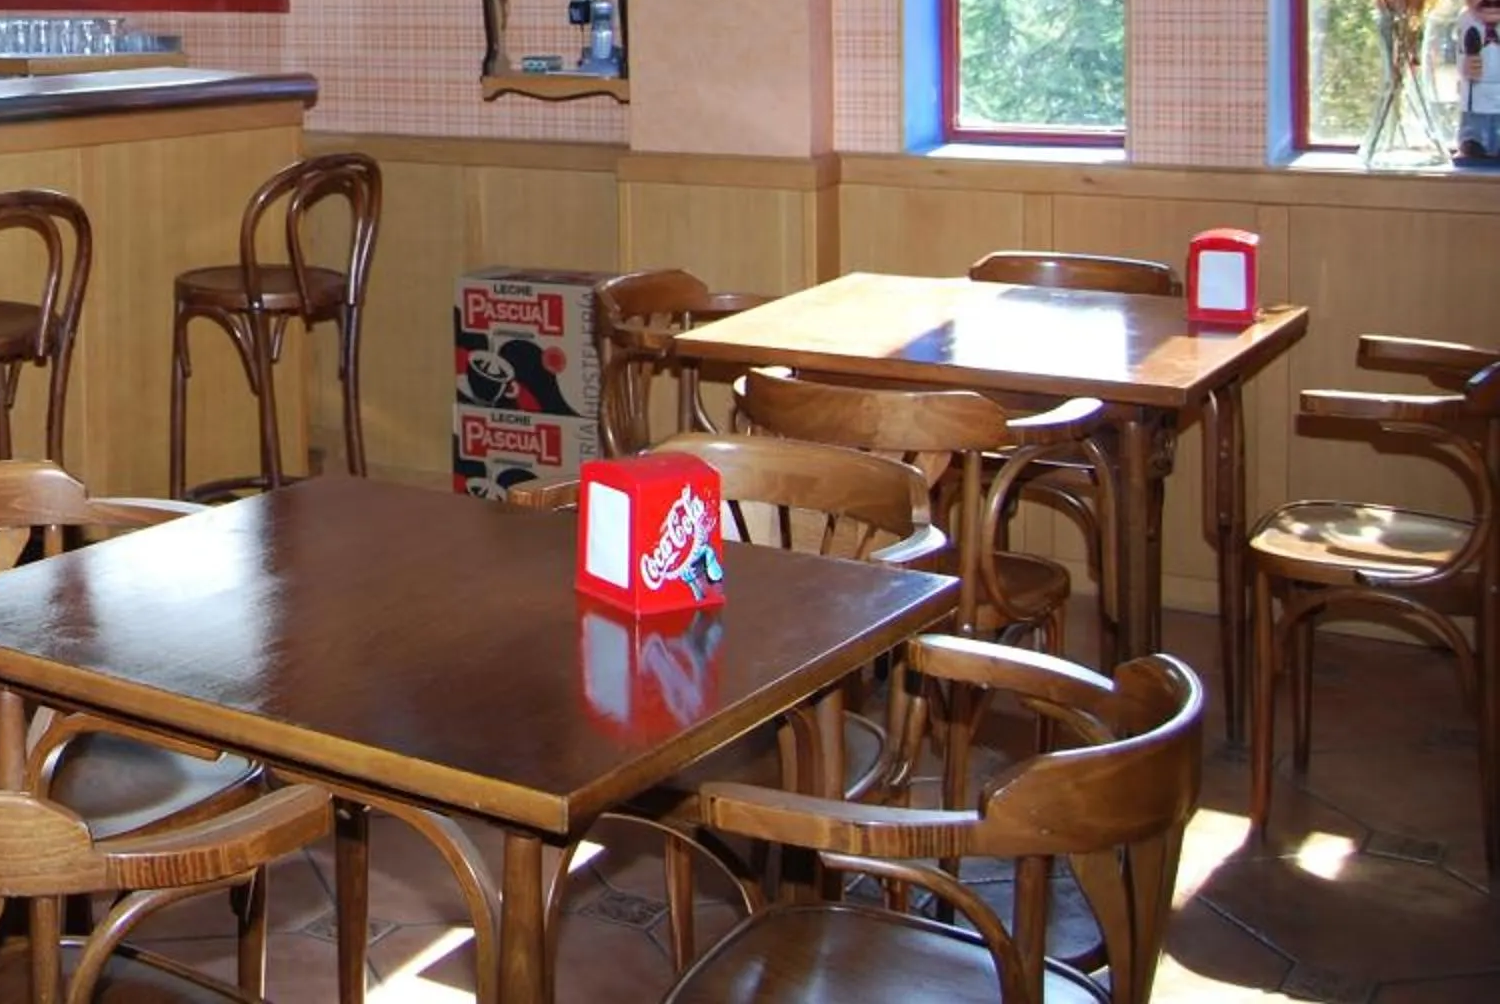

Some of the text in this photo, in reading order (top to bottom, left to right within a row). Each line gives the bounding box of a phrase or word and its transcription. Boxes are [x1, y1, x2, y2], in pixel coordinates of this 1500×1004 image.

[494, 284, 532, 296] LECHE
[467, 294, 560, 331] PASCUAL
[491, 412, 531, 425] LECHE
[465, 421, 560, 462] PASCUAL
